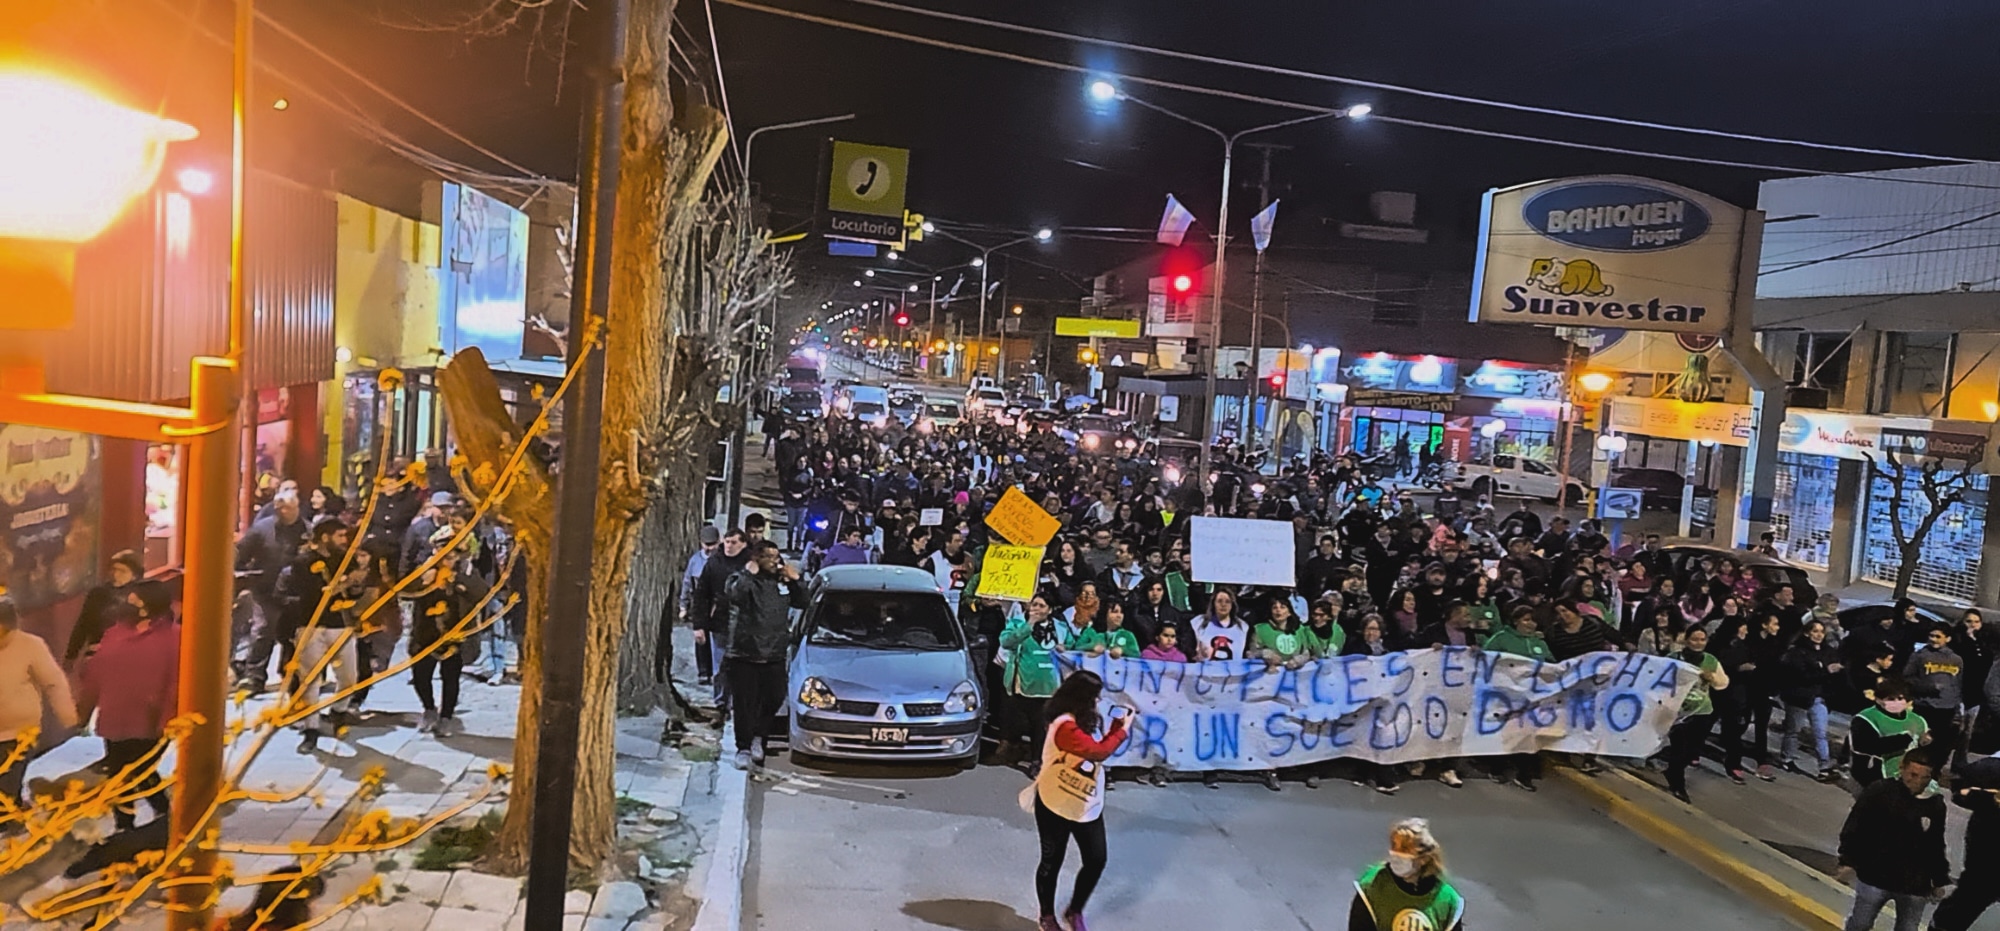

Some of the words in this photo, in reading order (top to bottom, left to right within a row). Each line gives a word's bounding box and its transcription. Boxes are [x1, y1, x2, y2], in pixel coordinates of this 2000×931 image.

[831, 216, 897, 236] Locutorio
[1631, 228, 1683, 246] Hogar
[1502, 285, 1706, 323] Suavestar
[1442, 645, 1500, 688] EN
[1530, 650, 1679, 698] LUCHA
[1193, 712, 1241, 762] UN
